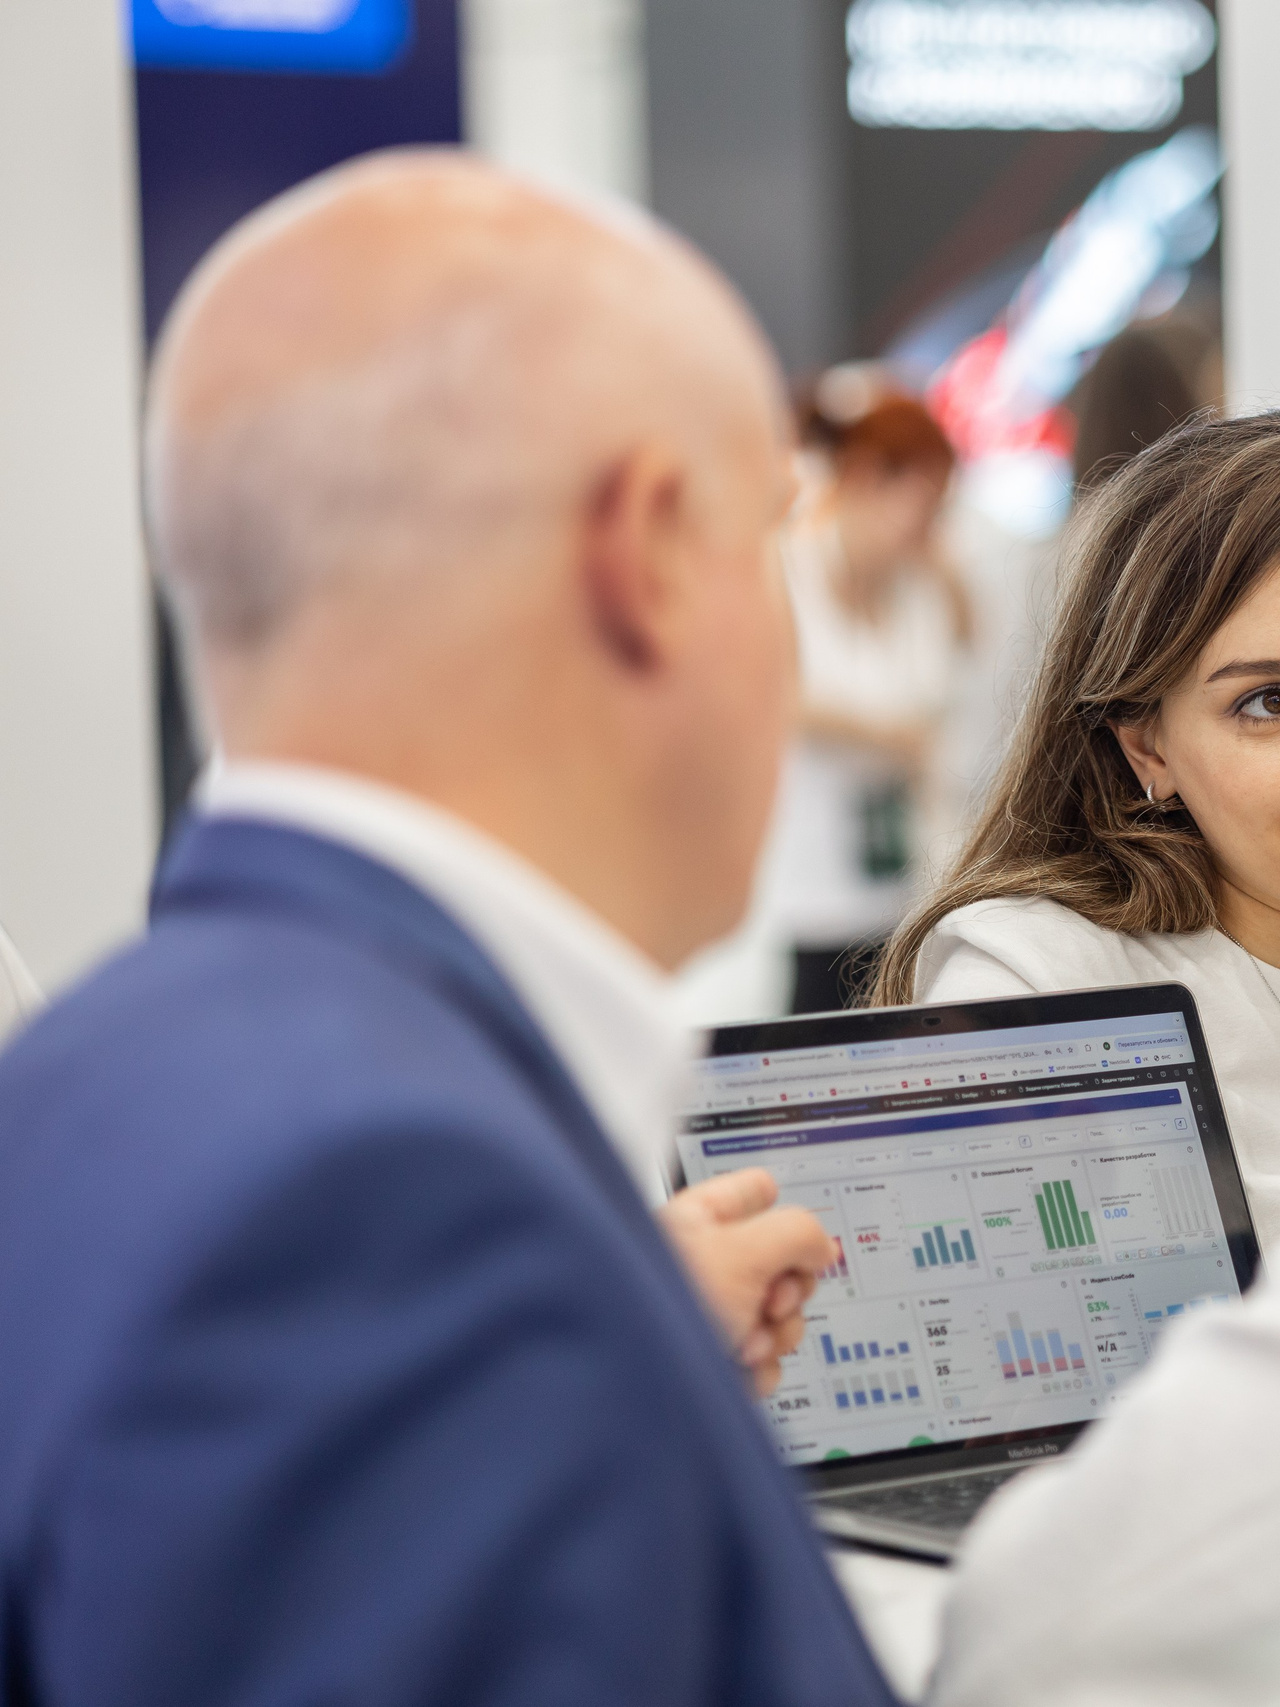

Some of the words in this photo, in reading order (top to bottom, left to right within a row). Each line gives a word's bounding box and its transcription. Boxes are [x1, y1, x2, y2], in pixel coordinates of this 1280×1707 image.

[1118, 1040, 1152, 1048] Перезапустить
[1100, 1155, 1124, 1163] Качество
[1125, 1152, 1156, 1161] разработки
[1104, 1207, 1128, 1219] 0,00
[983, 1216, 1012, 1228] 100%
[857, 1232, 880, 1243] 46%
[1090, 1276, 1110, 1284] Индекс
[1111, 1273, 1135, 1281] LowCode
[927, 1326, 947, 1337] 365
[936, 1366, 950, 1376] 25
[1008, 1445, 1044, 1458] MacBook
[1045, 1444, 1058, 1453] Pro
